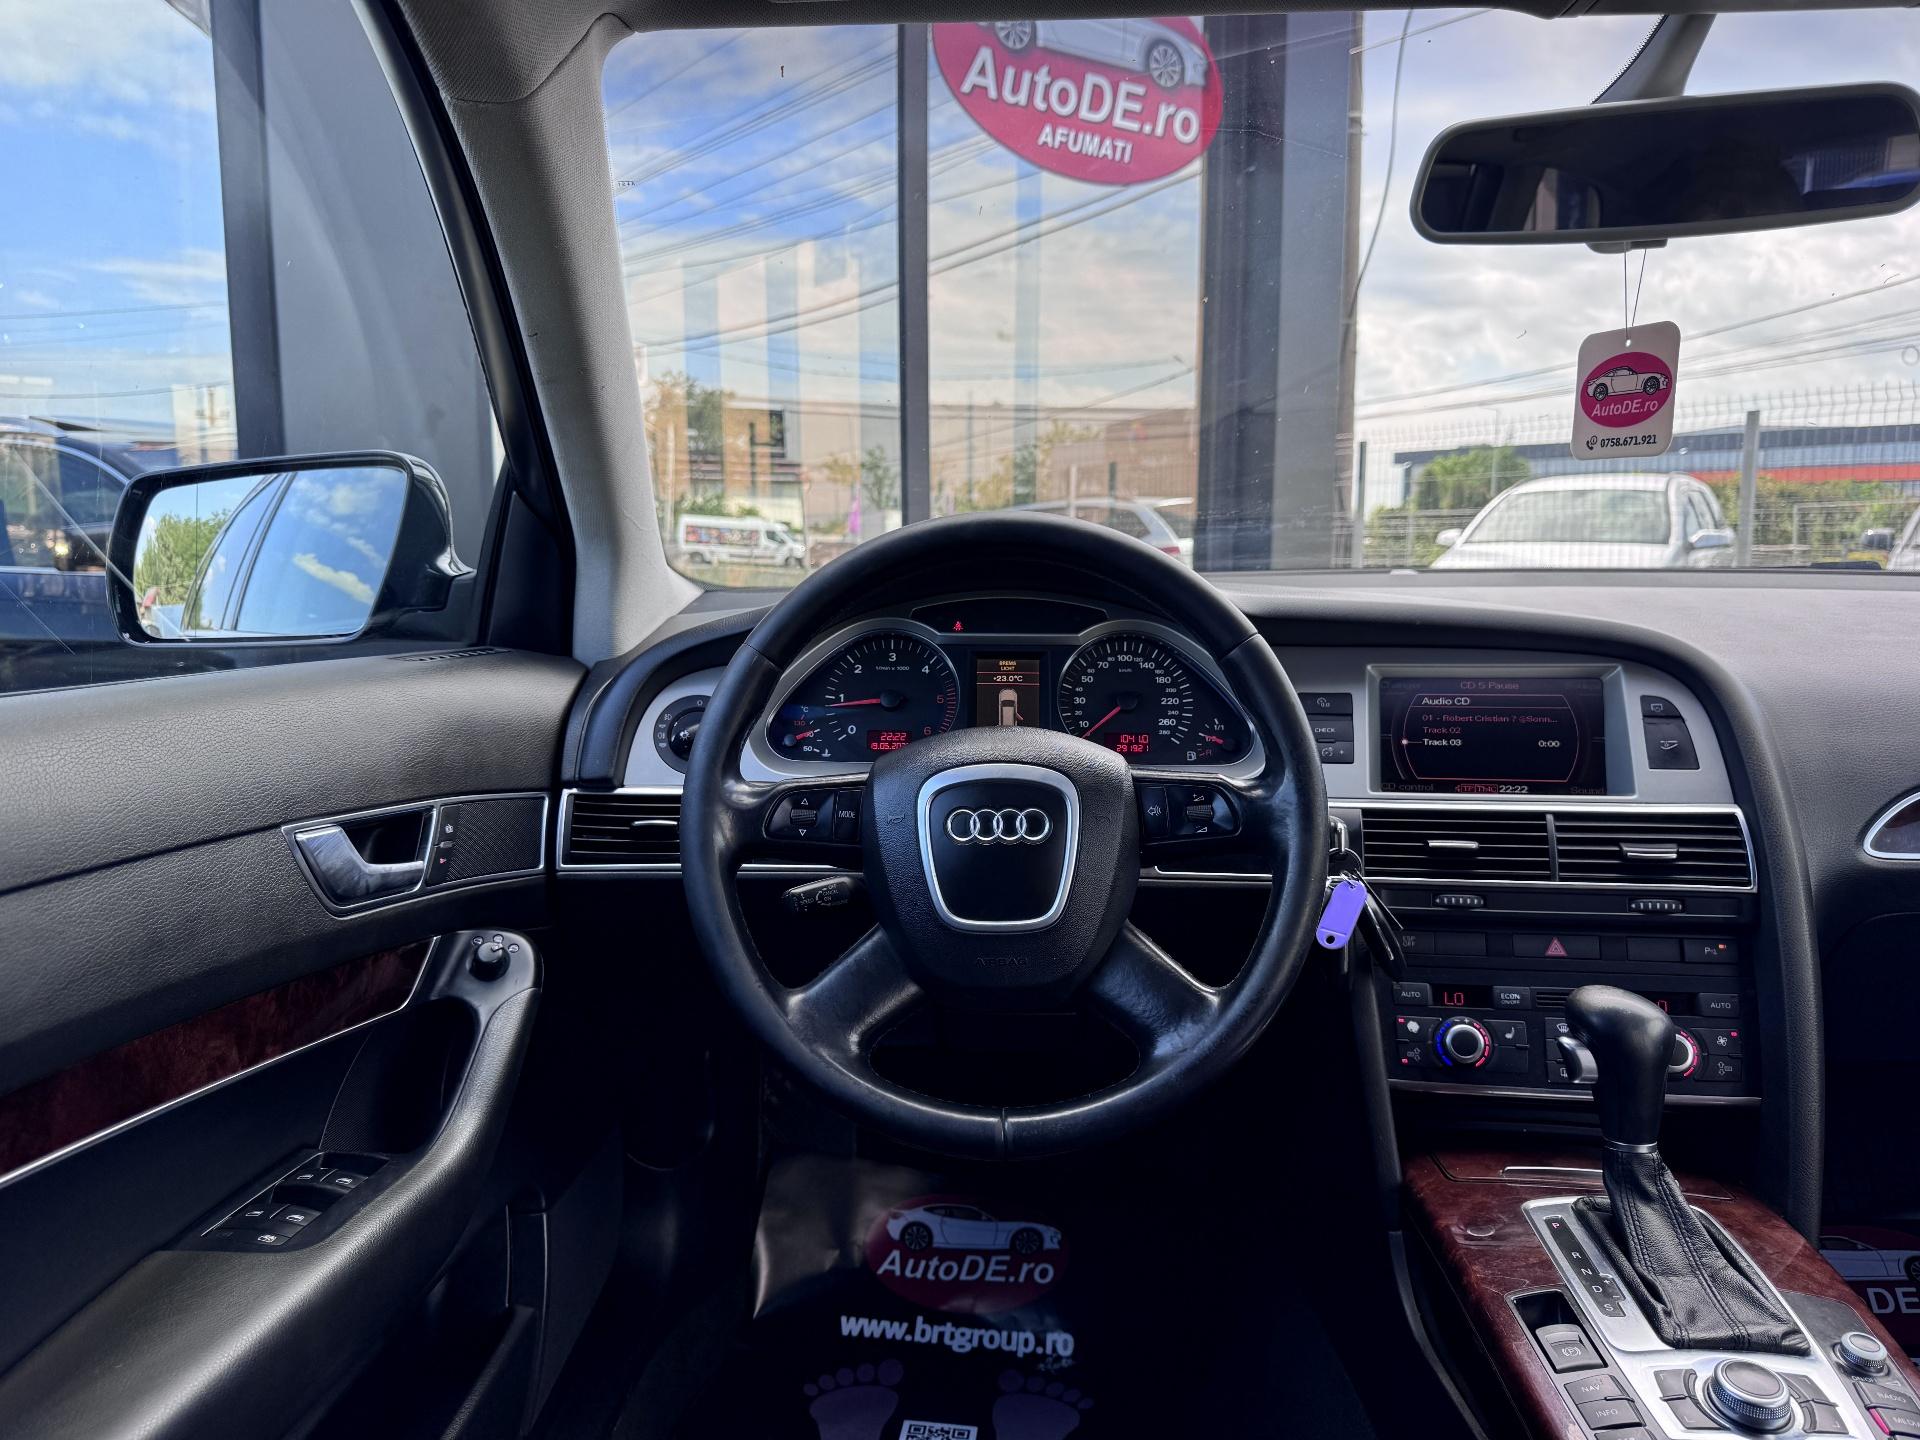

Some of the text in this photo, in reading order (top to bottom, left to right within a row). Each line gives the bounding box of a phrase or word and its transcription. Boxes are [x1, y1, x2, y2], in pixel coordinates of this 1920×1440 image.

[960, 46, 1200, 144] AutoDE.ro
[1037, 123, 1133, 164] AFUMATI
[1591, 398, 1659, 418] AutoDE.ro
[1600, 434, 1657, 448] 0758.671.921
[888, 652, 897, 662] 3
[854, 664, 862, 674] 2
[921, 665, 930, 674] 4
[1097, 661, 1109, 669] 70
[1155, 676, 1172, 684] 180
[1488, 682, 1520, 690] Pause
[838, 694, 845, 702] 1
[1422, 697, 1470, 706] Audio CD
[848, 725, 856, 734] 0
[880, 732, 907, 741] 22:22
[870, 742, 910, 750] 19.05.20
[1499, 786, 1528, 794] 22:22
[838, 810, 856, 819] MODE
[876, 1249, 1054, 1284] AutoDE.ro
[840, 1315, 1074, 1357] www.brtgroup.ro
[1581, 1384, 1600, 1393] NAV
[1596, 1408, 1618, 1418] INFO
